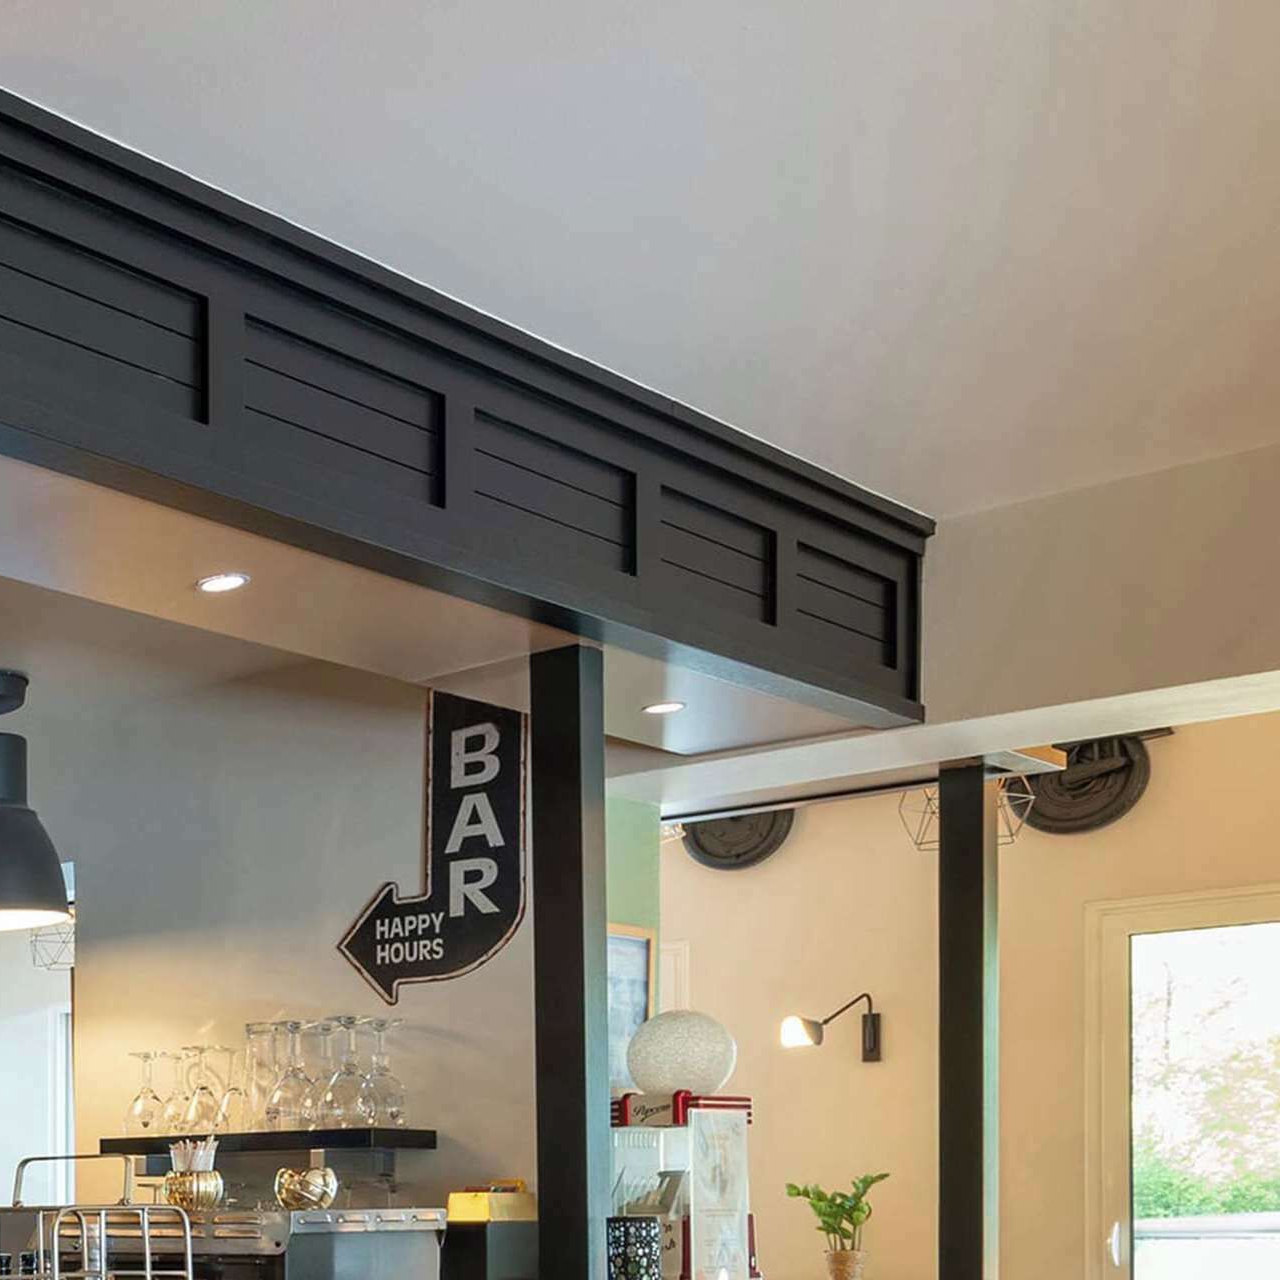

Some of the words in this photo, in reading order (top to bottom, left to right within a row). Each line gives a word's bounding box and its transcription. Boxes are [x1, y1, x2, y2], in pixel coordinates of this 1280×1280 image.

[445, 722, 505, 918] BAR
[376, 911, 445, 940] HAPPY
[376, 938, 444, 965] HOURS
